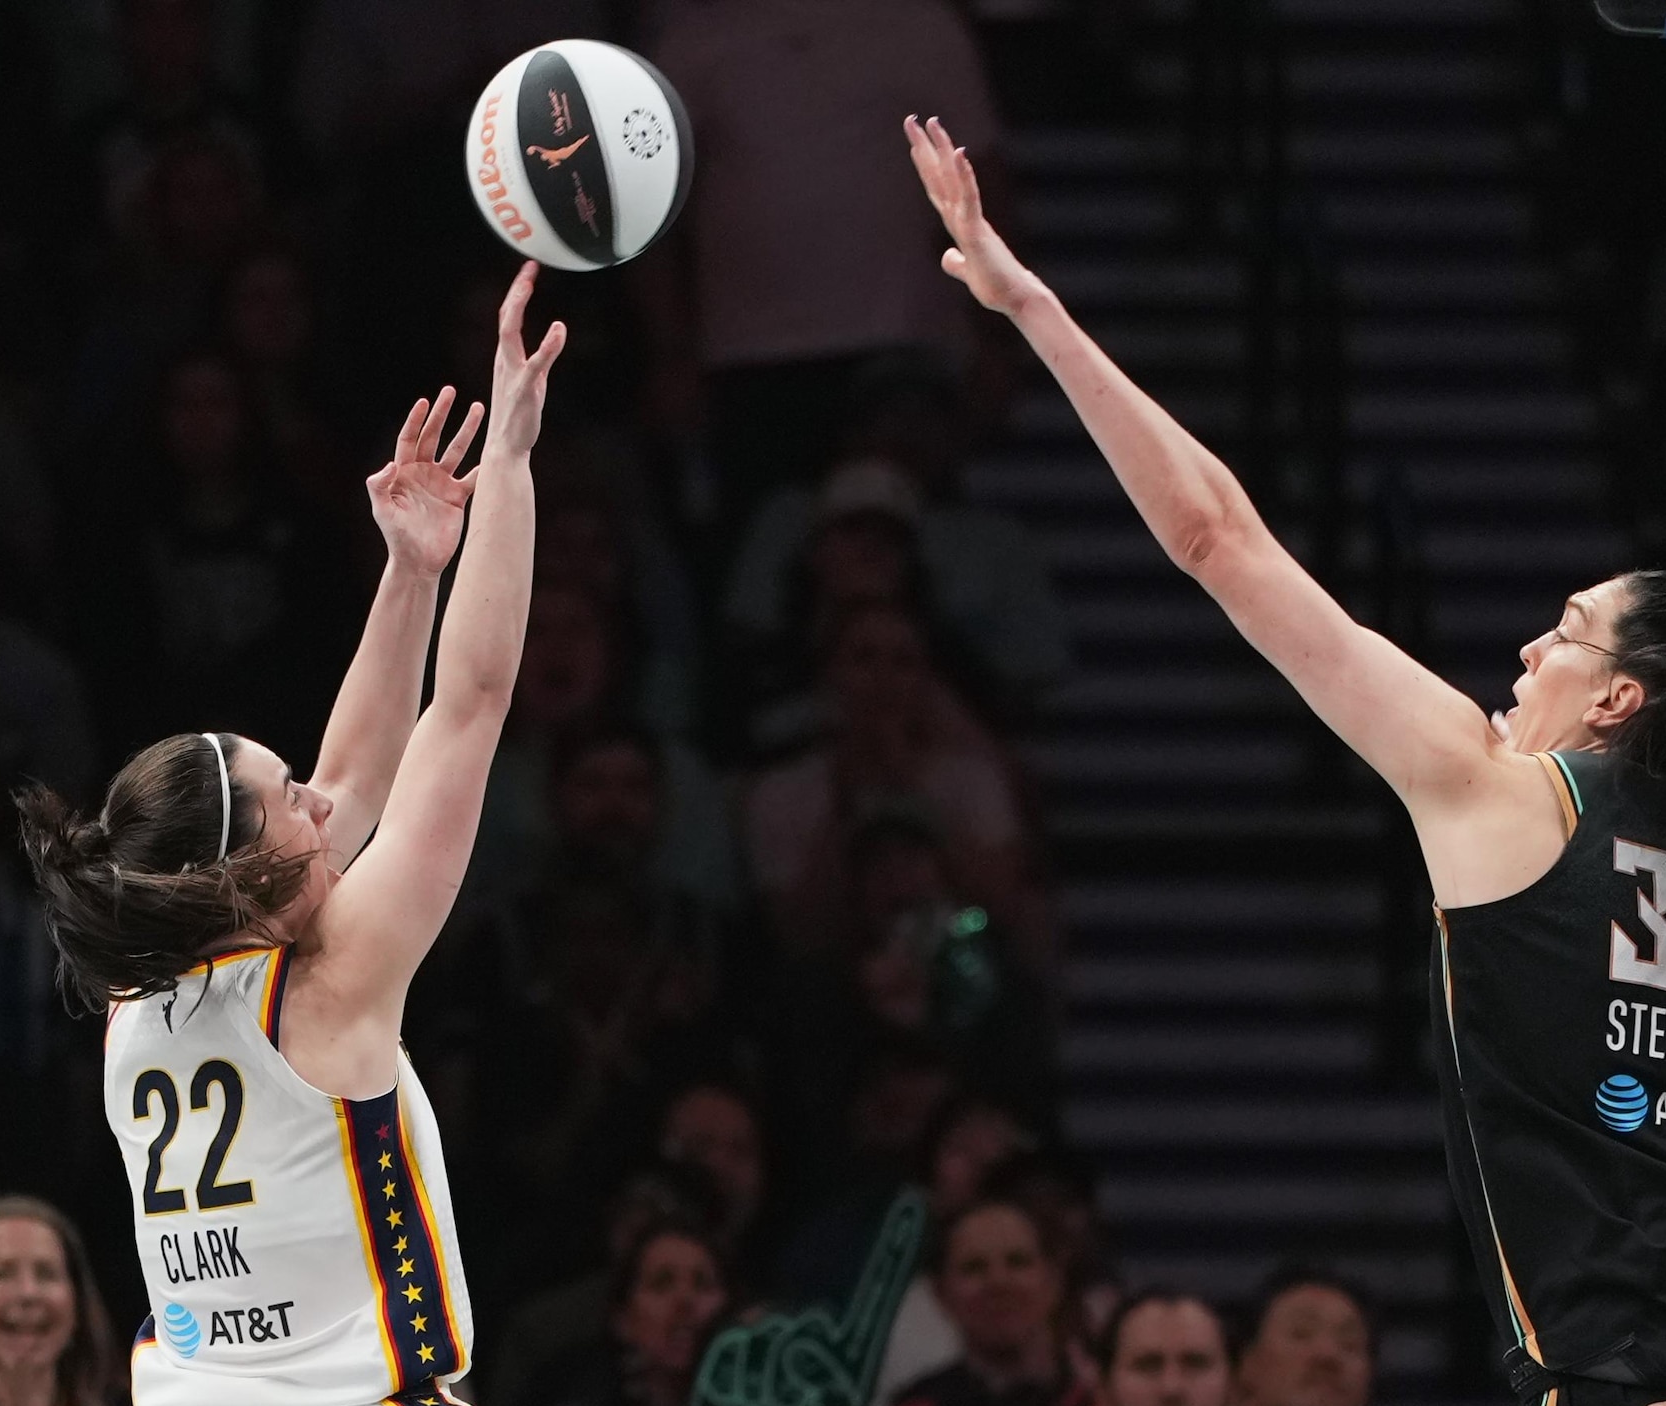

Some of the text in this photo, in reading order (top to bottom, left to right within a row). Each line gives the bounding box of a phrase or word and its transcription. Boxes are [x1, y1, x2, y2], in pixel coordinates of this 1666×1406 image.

[132, 1057, 256, 1217] 22
[160, 1226, 251, 1284] CLARK
[209, 1301, 295, 1347] AT&T
